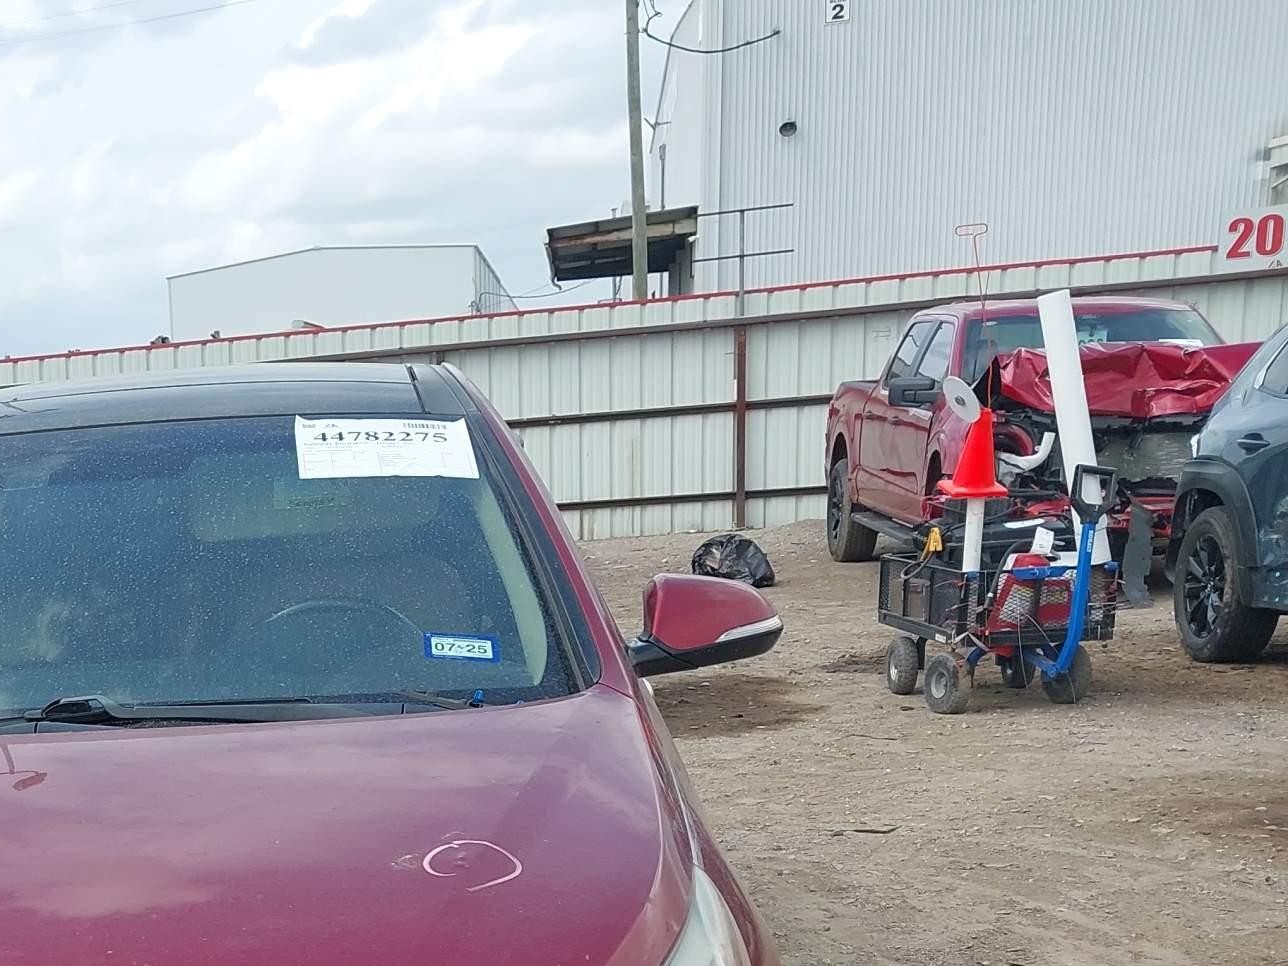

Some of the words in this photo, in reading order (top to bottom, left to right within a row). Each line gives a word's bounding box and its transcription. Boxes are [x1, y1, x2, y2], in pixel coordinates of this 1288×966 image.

[831, 3, 844, 20] 2
[1225, 213, 1284, 259] 20
[313, 430, 448, 443] 44782275
